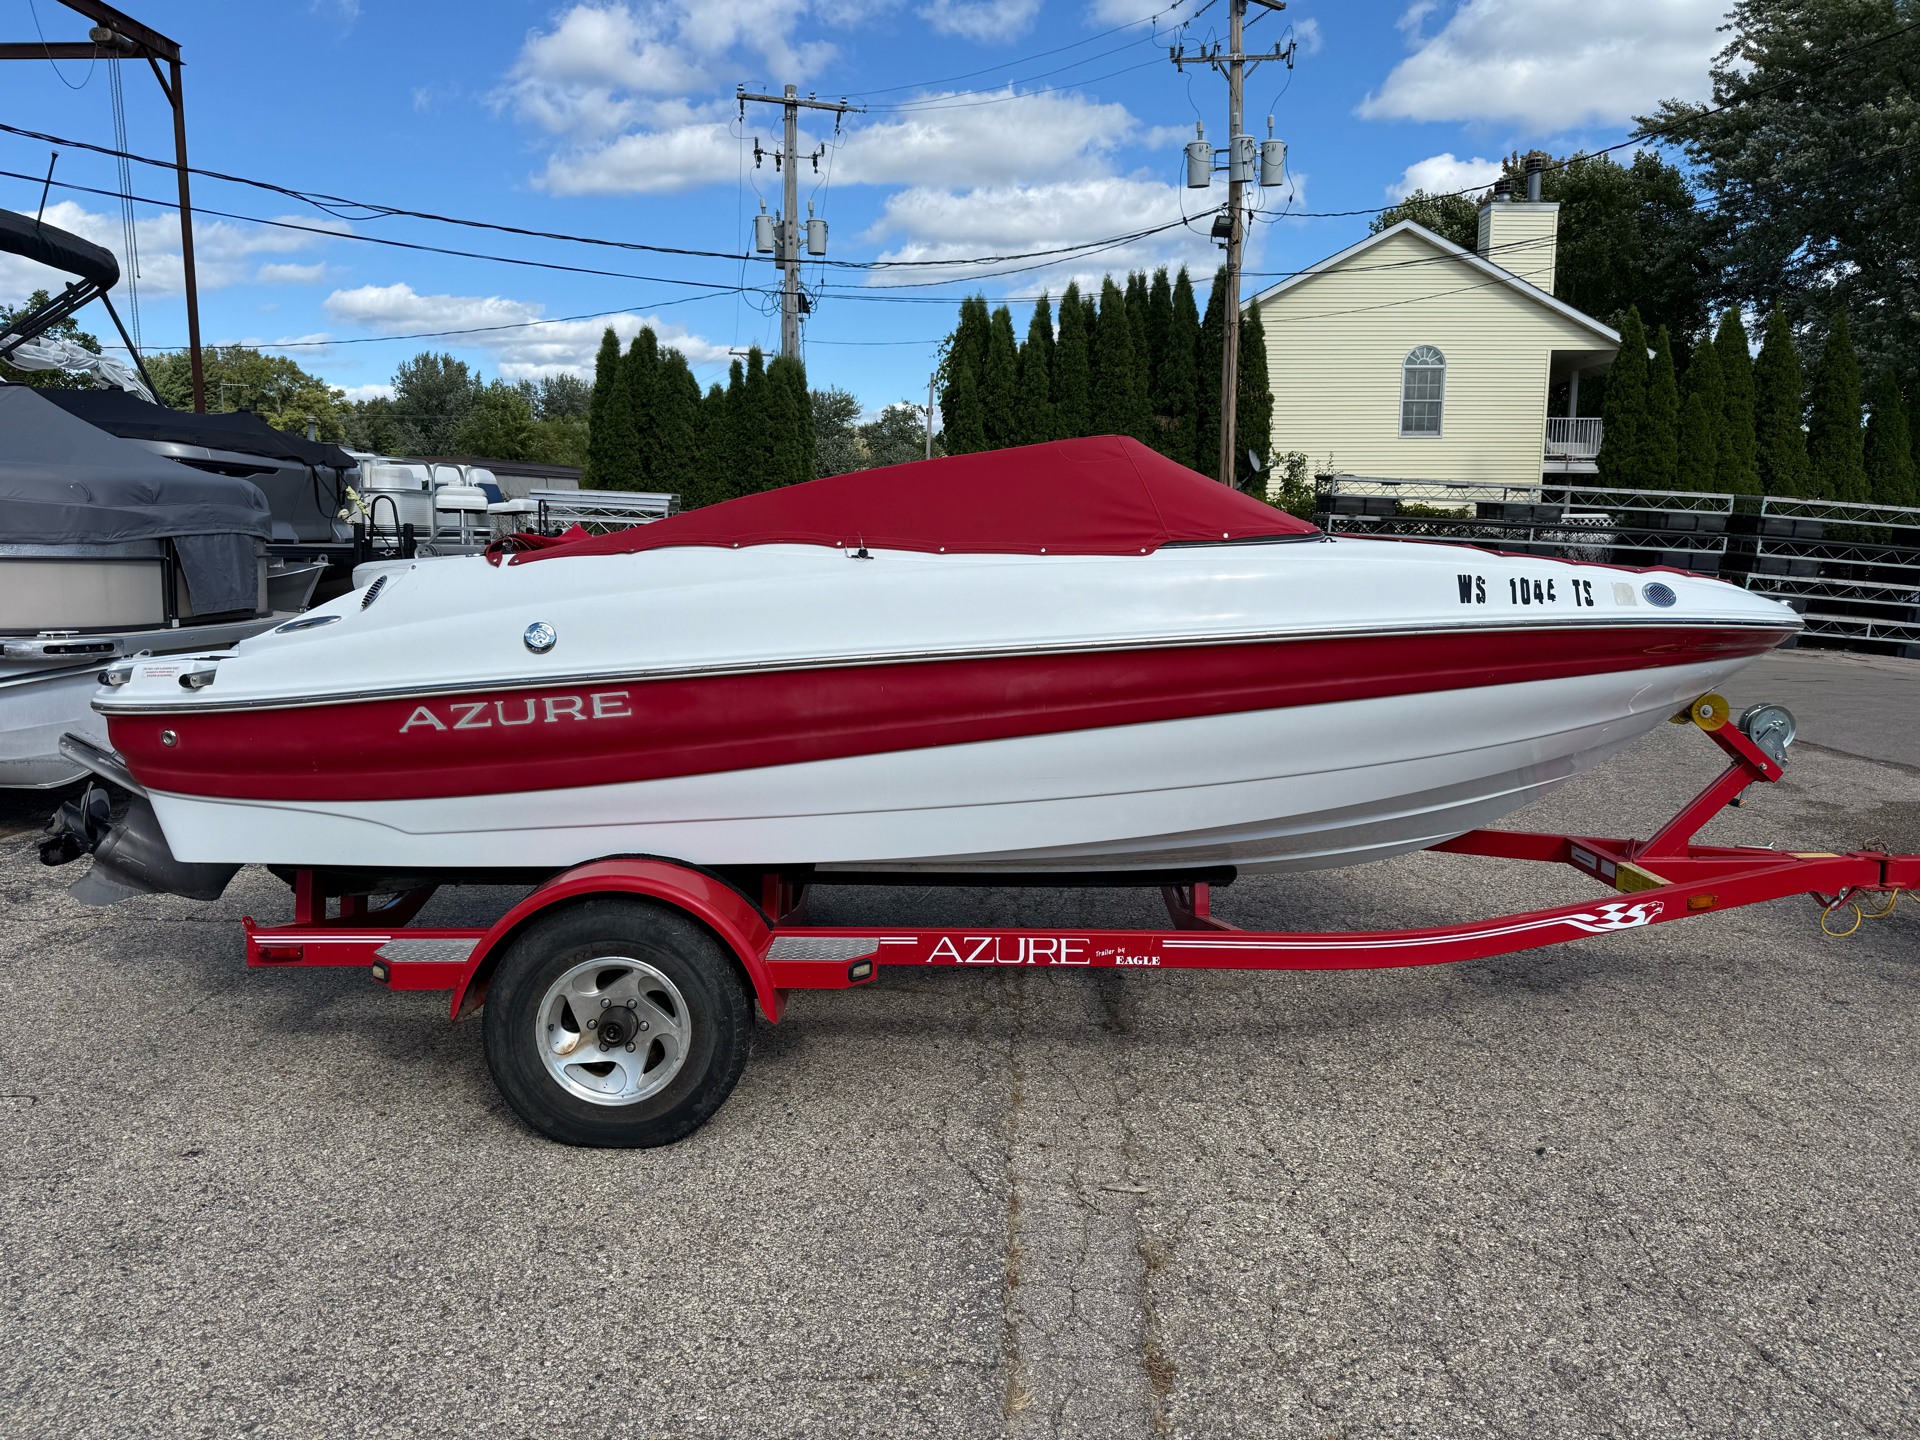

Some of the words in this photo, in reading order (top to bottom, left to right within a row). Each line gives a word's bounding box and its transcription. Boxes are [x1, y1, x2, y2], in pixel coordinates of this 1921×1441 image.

[1457, 574, 1486, 605] WS
[1571, 579, 1594, 607] TS
[399, 691, 632, 733] AZURE
[925, 936, 1090, 965] AZURE
[1095, 948, 1115, 957] Trailer
[1117, 946, 1126, 954] by
[1115, 955, 1161, 966] EAGLE
